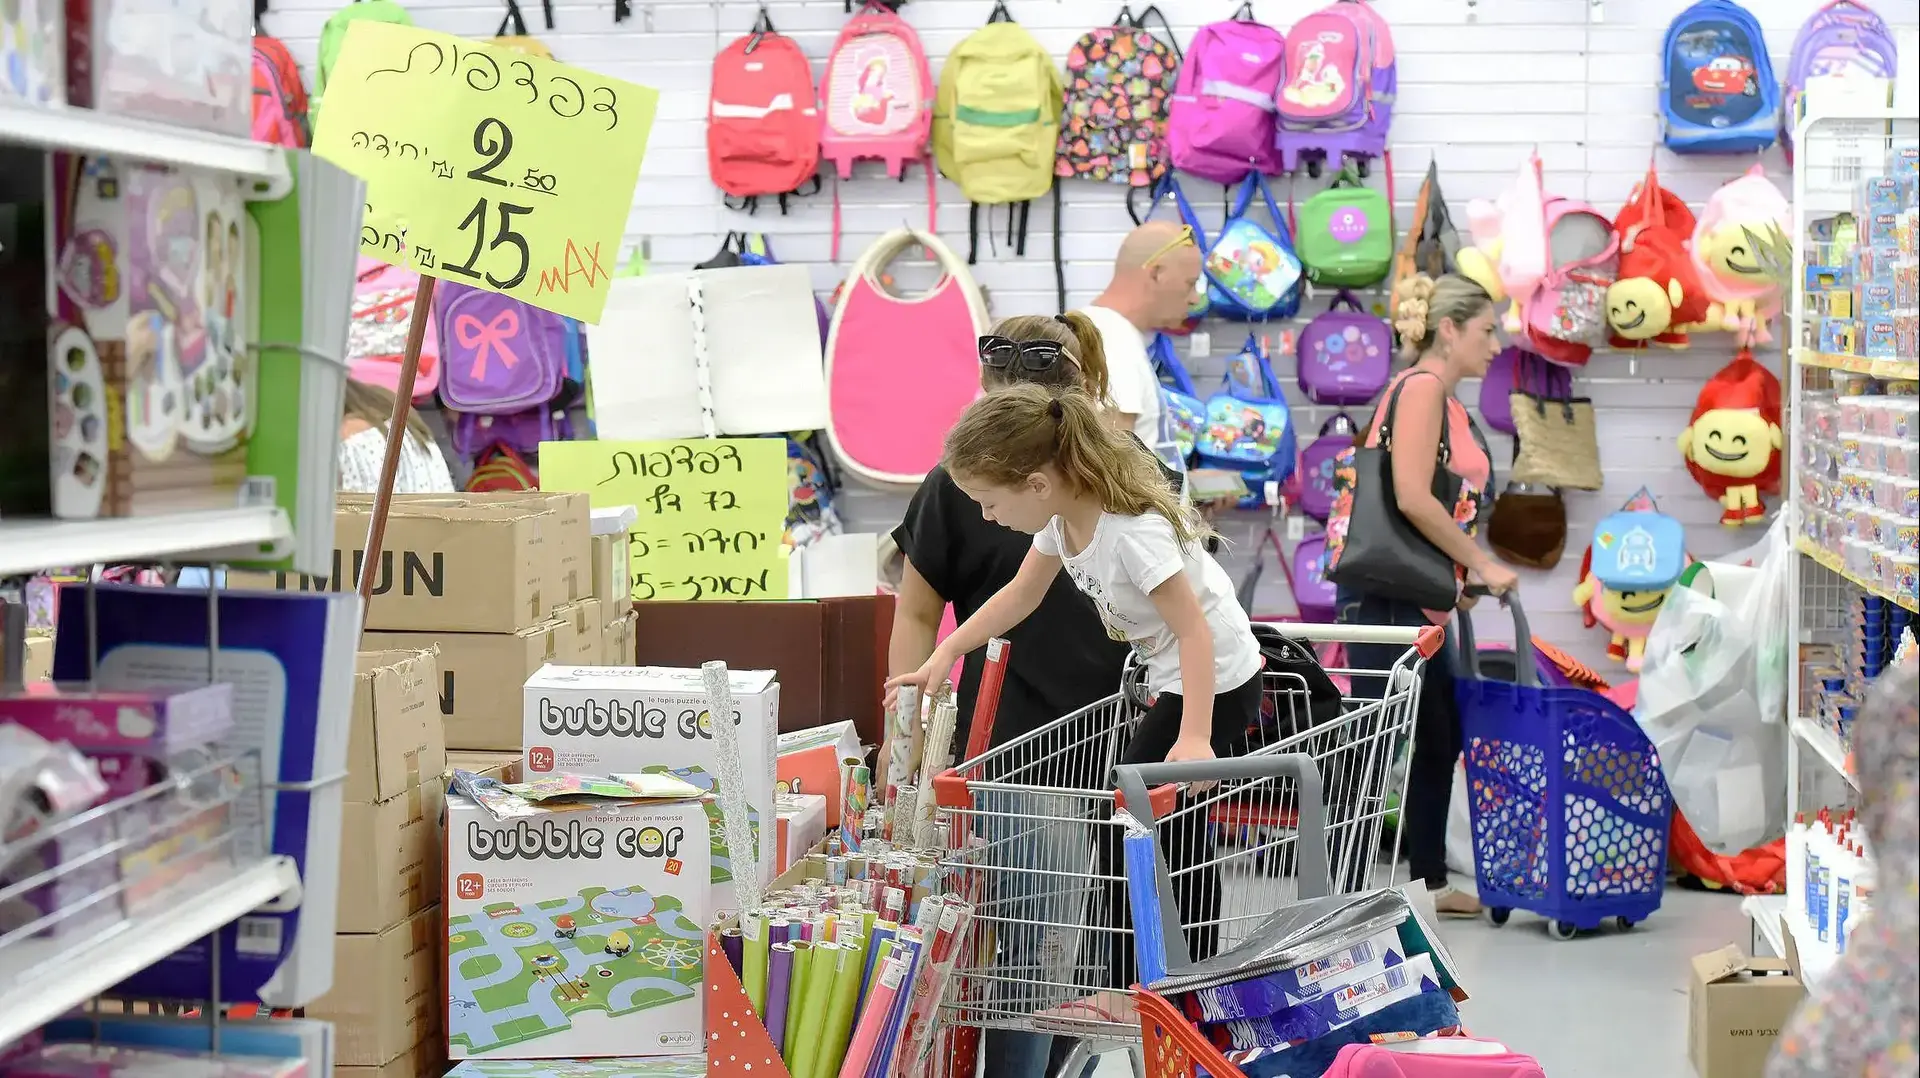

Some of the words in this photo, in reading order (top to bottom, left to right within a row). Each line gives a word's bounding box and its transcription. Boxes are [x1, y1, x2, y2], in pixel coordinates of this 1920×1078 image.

[366, 42, 618, 131] דפדפות
[441, 197, 534, 290] 15
[597, 445, 742, 486] דפדפות
[701, 491, 741, 511] 72
[682, 528, 766, 554] יחידה
[540, 697, 666, 739] bubble
[531, 752, 552, 765] 12+
[616, 814, 640, 823] puzzle
[467, 819, 605, 861] bubble
[616, 826, 684, 858] car
[667, 861, 679, 872] 20
[459, 879, 482, 892] 12+
